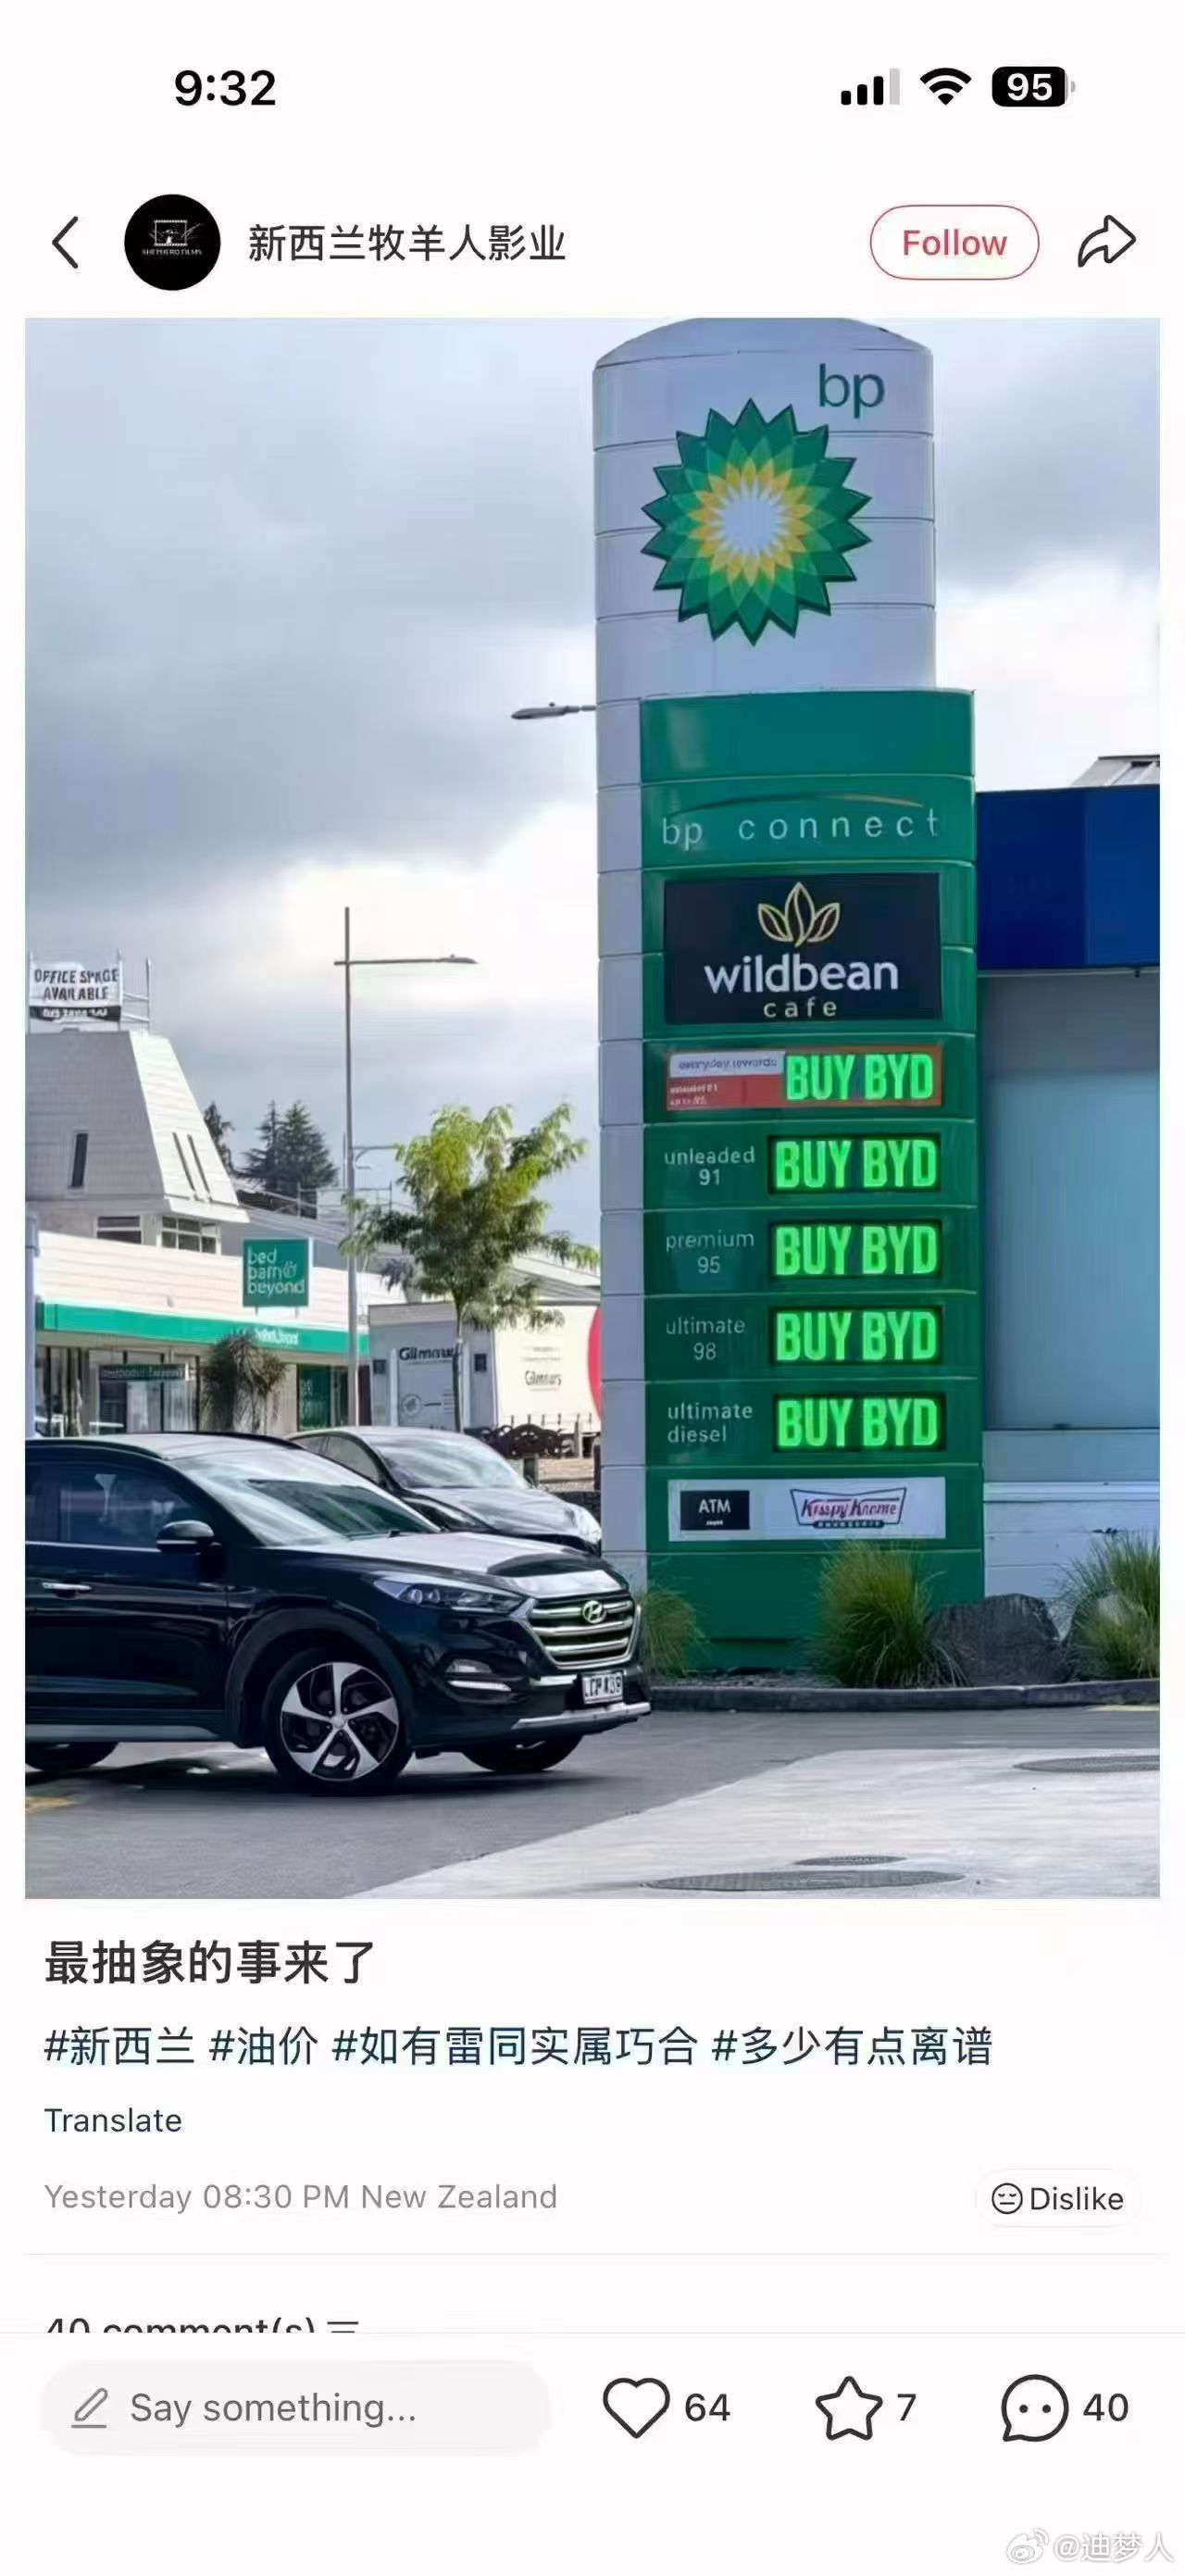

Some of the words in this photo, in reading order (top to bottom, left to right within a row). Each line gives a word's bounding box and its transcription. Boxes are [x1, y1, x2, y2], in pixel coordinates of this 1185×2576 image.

[818, 364, 886, 419] bp
[662, 818, 703, 851] bp
[739, 808, 940, 841] connect
[34, 969, 77, 983] OFFICE
[704, 954, 899, 994] wildbean
[43, 986, 109, 1000] AVAILABLE
[763, 996, 838, 1018] cafe
[787, 1056, 855, 1100] BUY
[864, 1054, 934, 1100] BYD
[665, 1146, 755, 1165] unleaded
[776, 1140, 852, 1188] BUY
[862, 1139, 937, 1188] BYD
[698, 1169, 721, 1186] 91
[666, 1231, 755, 1252] premium
[776, 1226, 852, 1276] BUY
[862, 1225, 938, 1275] BYD
[247, 1246, 277, 1265] bed
[697, 1256, 720, 1274] 95
[247, 1279, 306, 1298] beyond
[666, 1316, 746, 1334] ultimate
[776, 1311, 852, 1361] BUY
[862, 1311, 937, 1361] BYD
[693, 1343, 717, 1360] 98
[667, 1403, 754, 1420] ultimate
[778, 1398, 854, 1448] BUY
[863, 1397, 939, 1447] BYD
[667, 1425, 727, 1444] diesel
[698, 1499, 731, 1514] ATM
